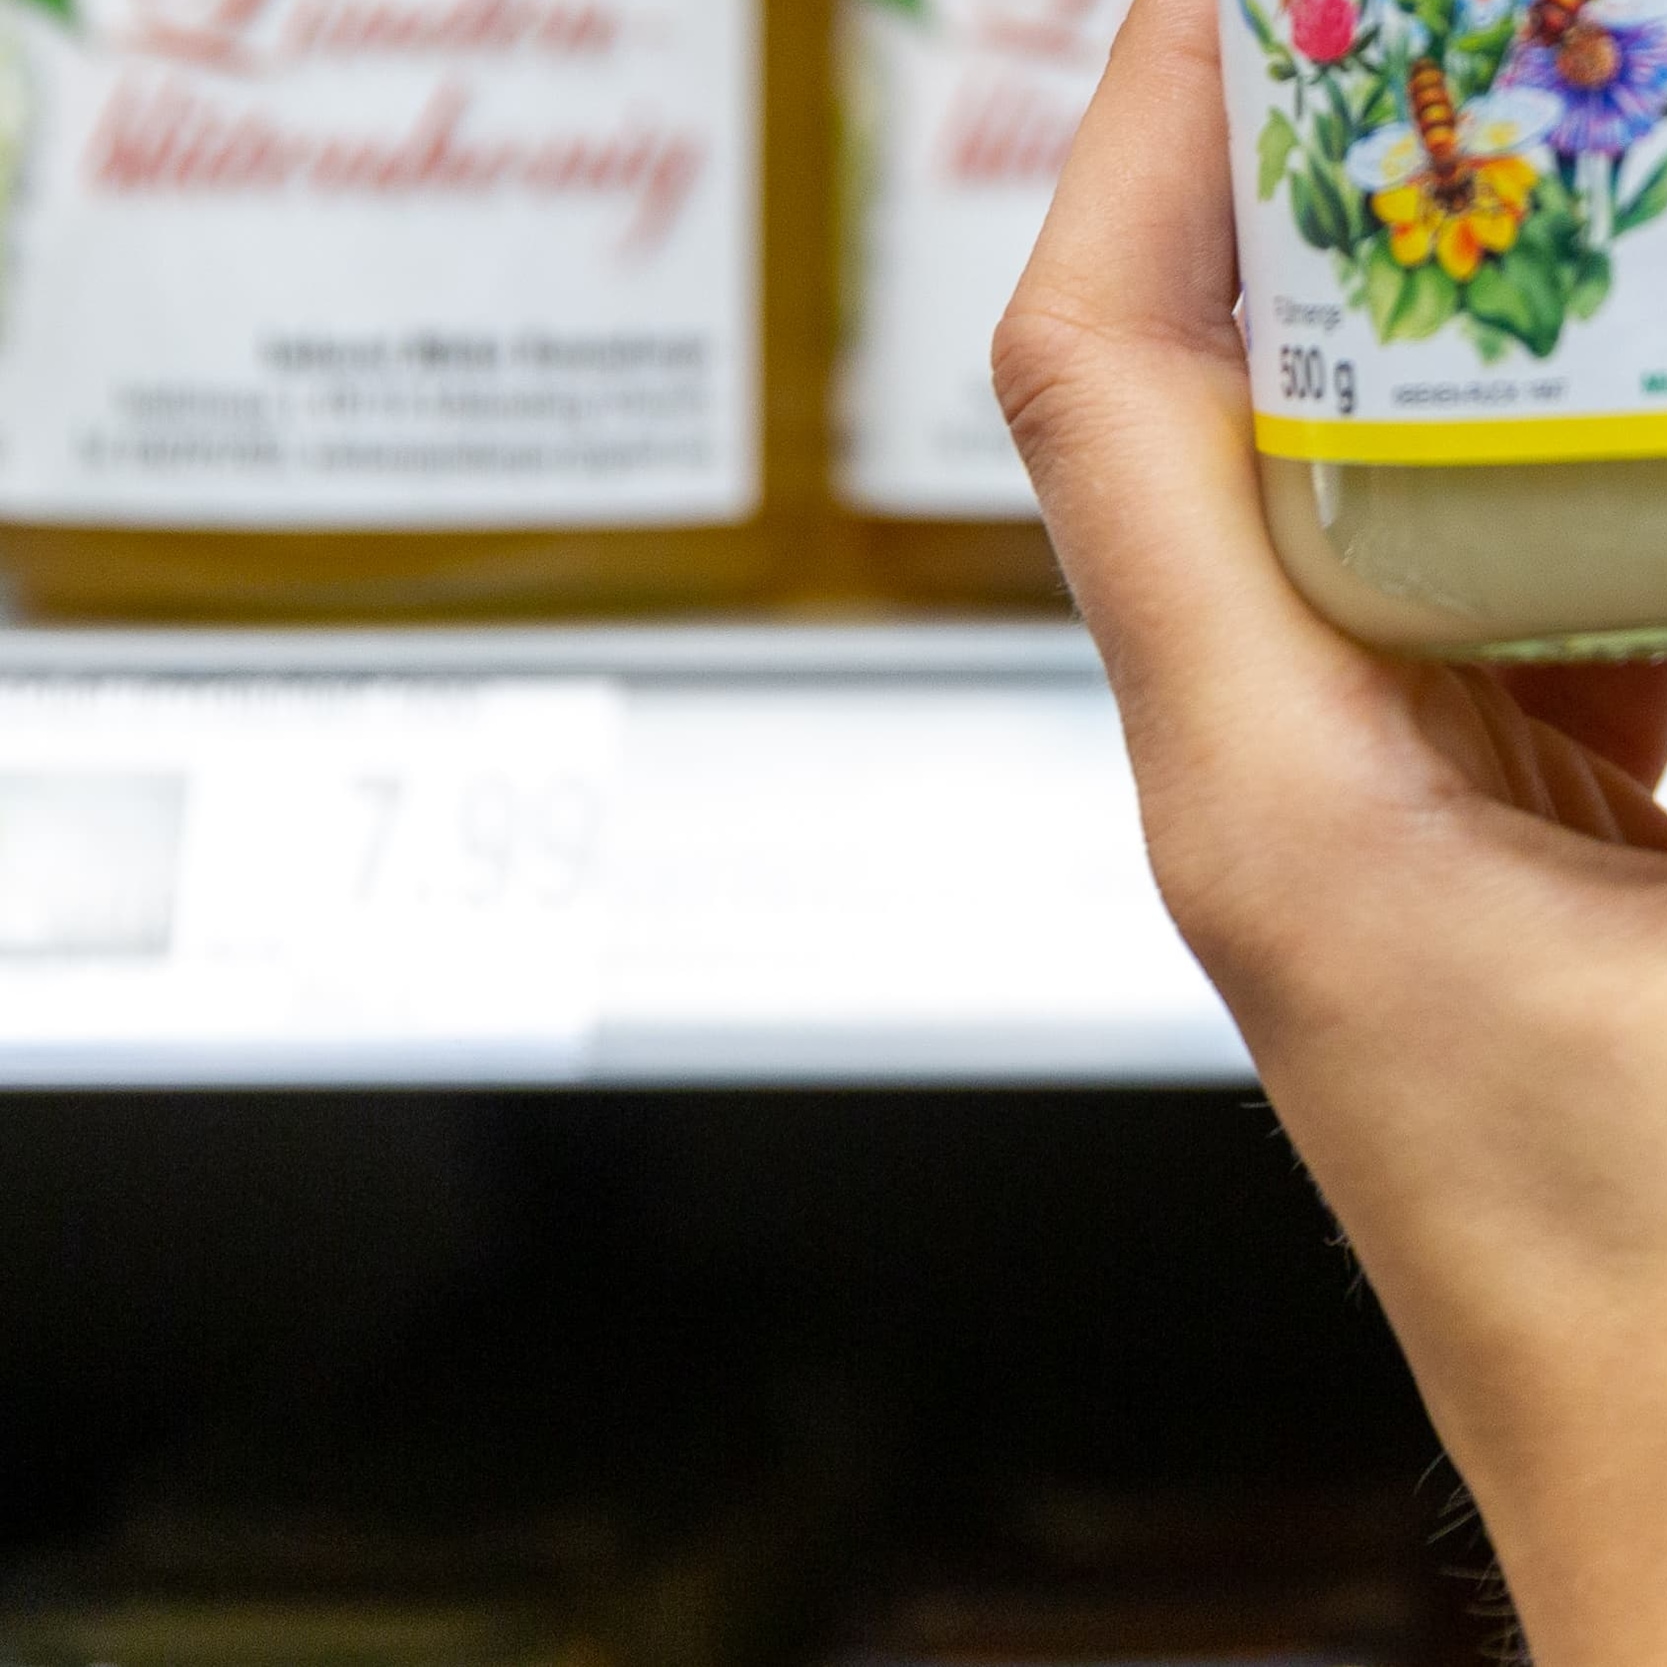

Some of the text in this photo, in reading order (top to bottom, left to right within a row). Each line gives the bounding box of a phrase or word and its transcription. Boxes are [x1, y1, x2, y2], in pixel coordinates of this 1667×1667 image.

[1280, 344, 1357, 414] 500 g
[350, 771, 604, 911] 7.99
